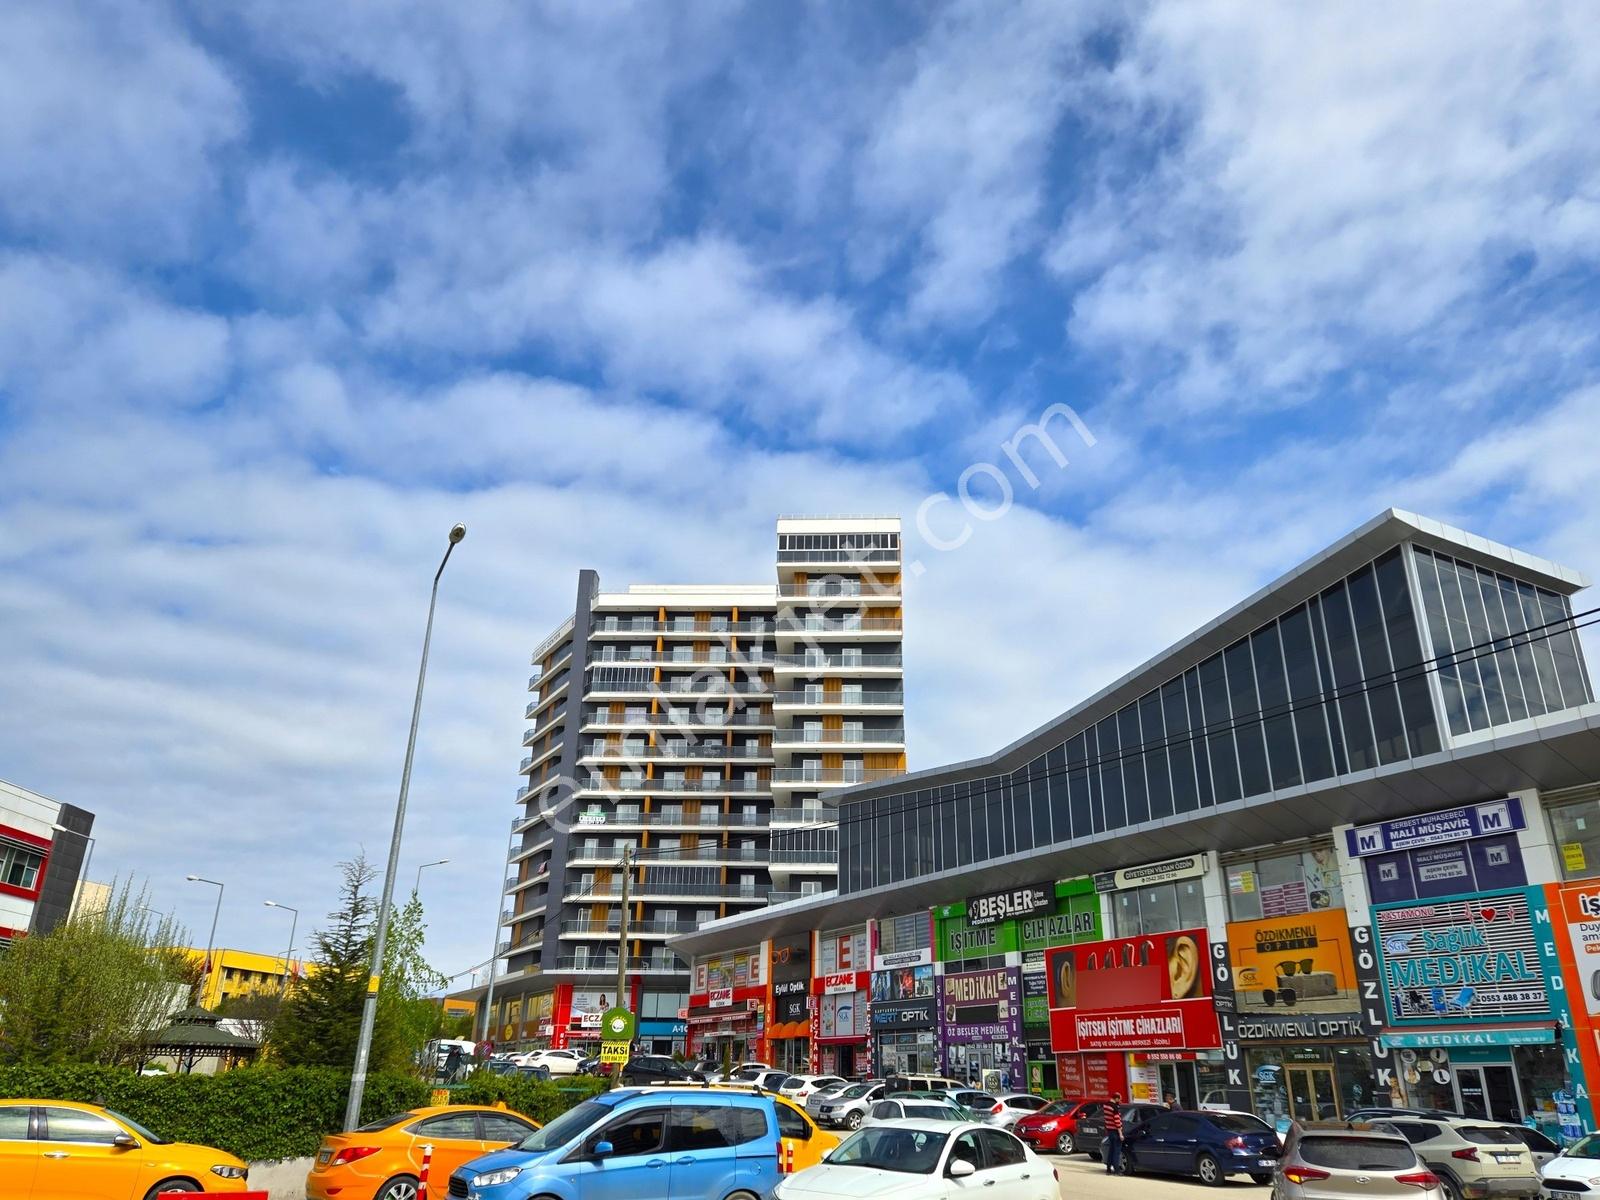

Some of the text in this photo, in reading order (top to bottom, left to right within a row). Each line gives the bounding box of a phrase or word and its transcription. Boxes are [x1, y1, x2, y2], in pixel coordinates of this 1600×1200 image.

[1390, 810, 1466, 830] SERBEST MUHASEBECİ
[1389, 818, 1471, 840] MALİ MÜŞAVİR
[979, 889, 1034, 920] BEŞLER
[1581, 895, 1600, 916] iş
[1380, 907, 1435, 922] KASTAMONU
[1388, 940, 1408, 951] SGK
[1422, 926, 1486, 953] Sağlık
[838, 934, 851, 970] E
[776, 982, 805, 995] Eylül Optik
[1532, 992, 1542, 1000] 37
[789, 1003, 800, 1012] SGK
[874, 1012, 897, 1024] MERT
[956, 1026, 979, 1038] BEŞLER
[980, 1024, 1009, 1036] MEDİKAL
[1077, 1014, 1182, 1040] İŞİTSEN İŞİTME CİHAZLARI
[1258, 1070, 1276, 1081] SGK
